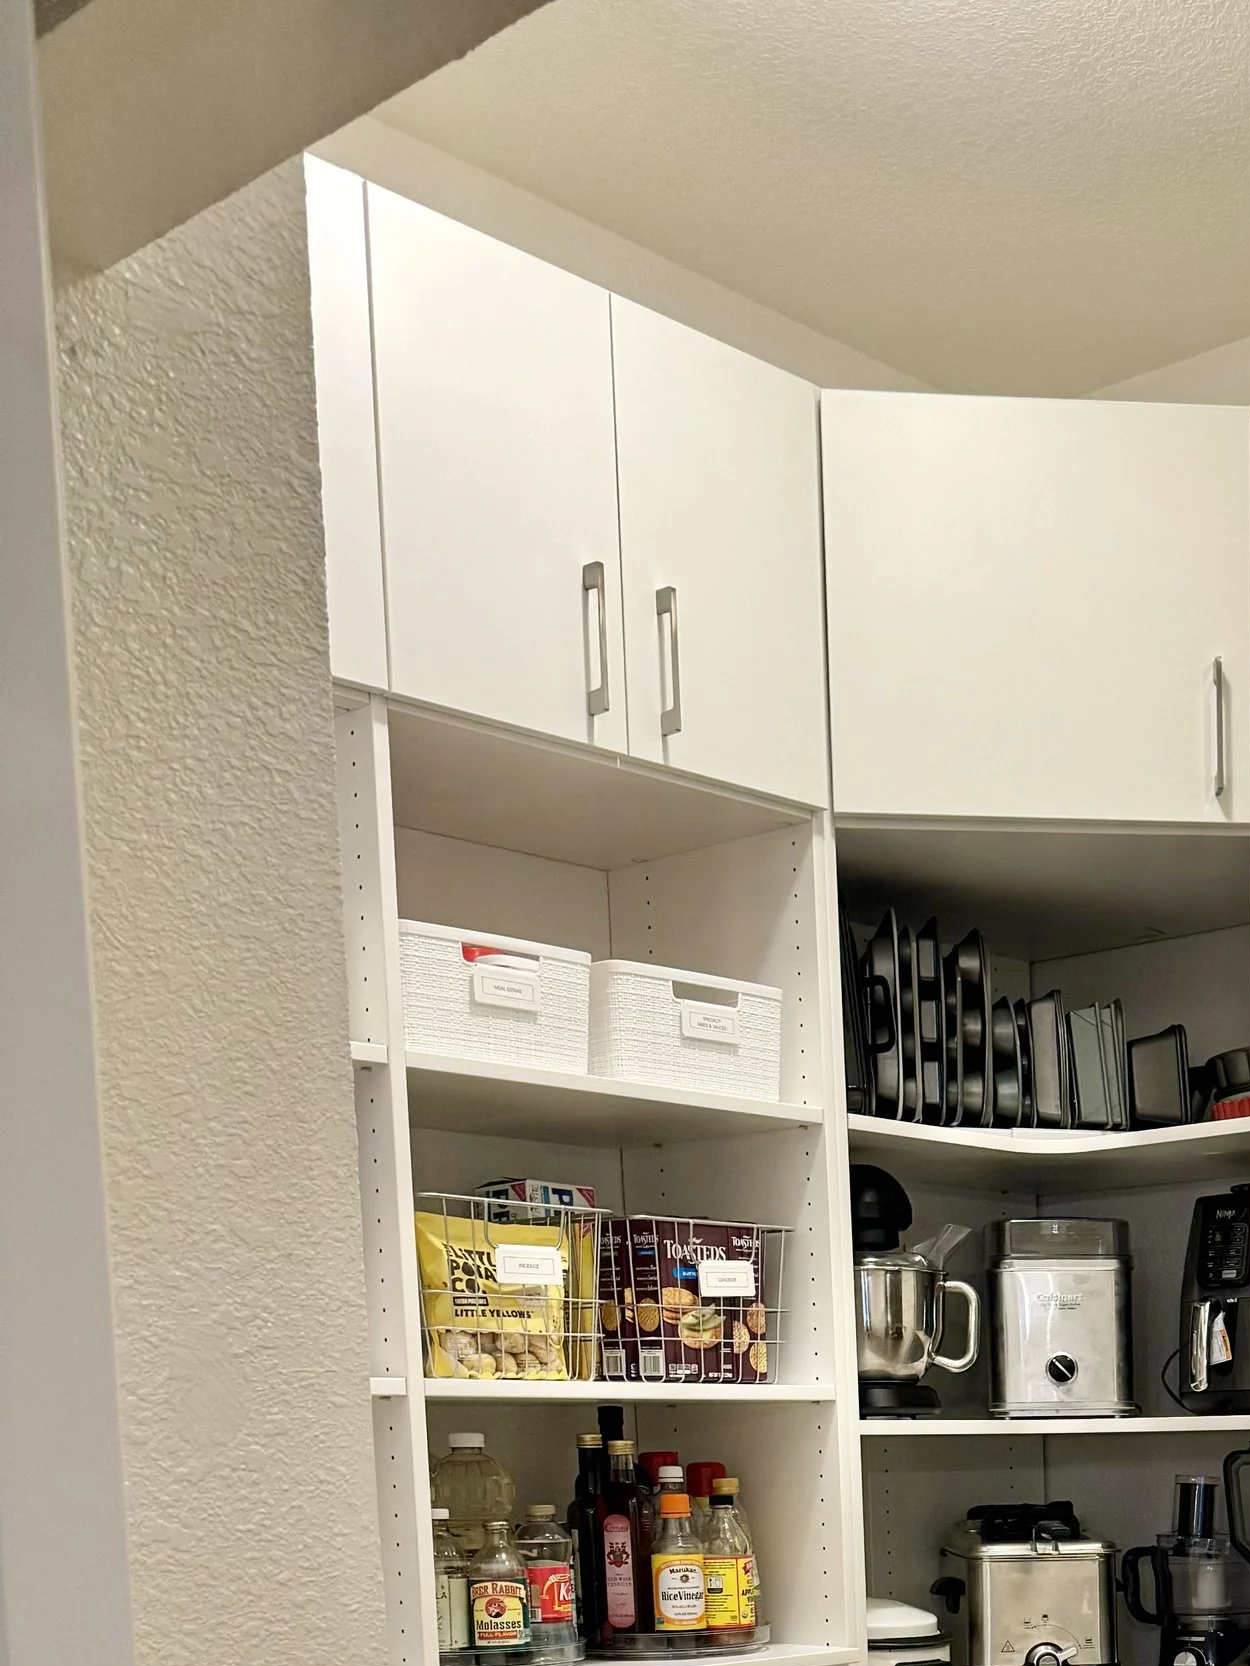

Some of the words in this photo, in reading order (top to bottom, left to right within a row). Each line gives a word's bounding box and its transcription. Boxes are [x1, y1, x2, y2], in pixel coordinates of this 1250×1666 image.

[1216, 1209, 1236, 1219] NINJA
[449, 1245, 497, 1267] LITTL
[664, 1239, 727, 1264] TOASTEDS
[450, 1259, 498, 1283] POTA
[489, 1309, 532, 1319] YELLOWS
[491, 1582, 522, 1595] RABBIT
[661, 1591, 679, 1601] Rice
[679, 1591, 704, 1601] Vinegar
[476, 1620, 521, 1631] Molasses
